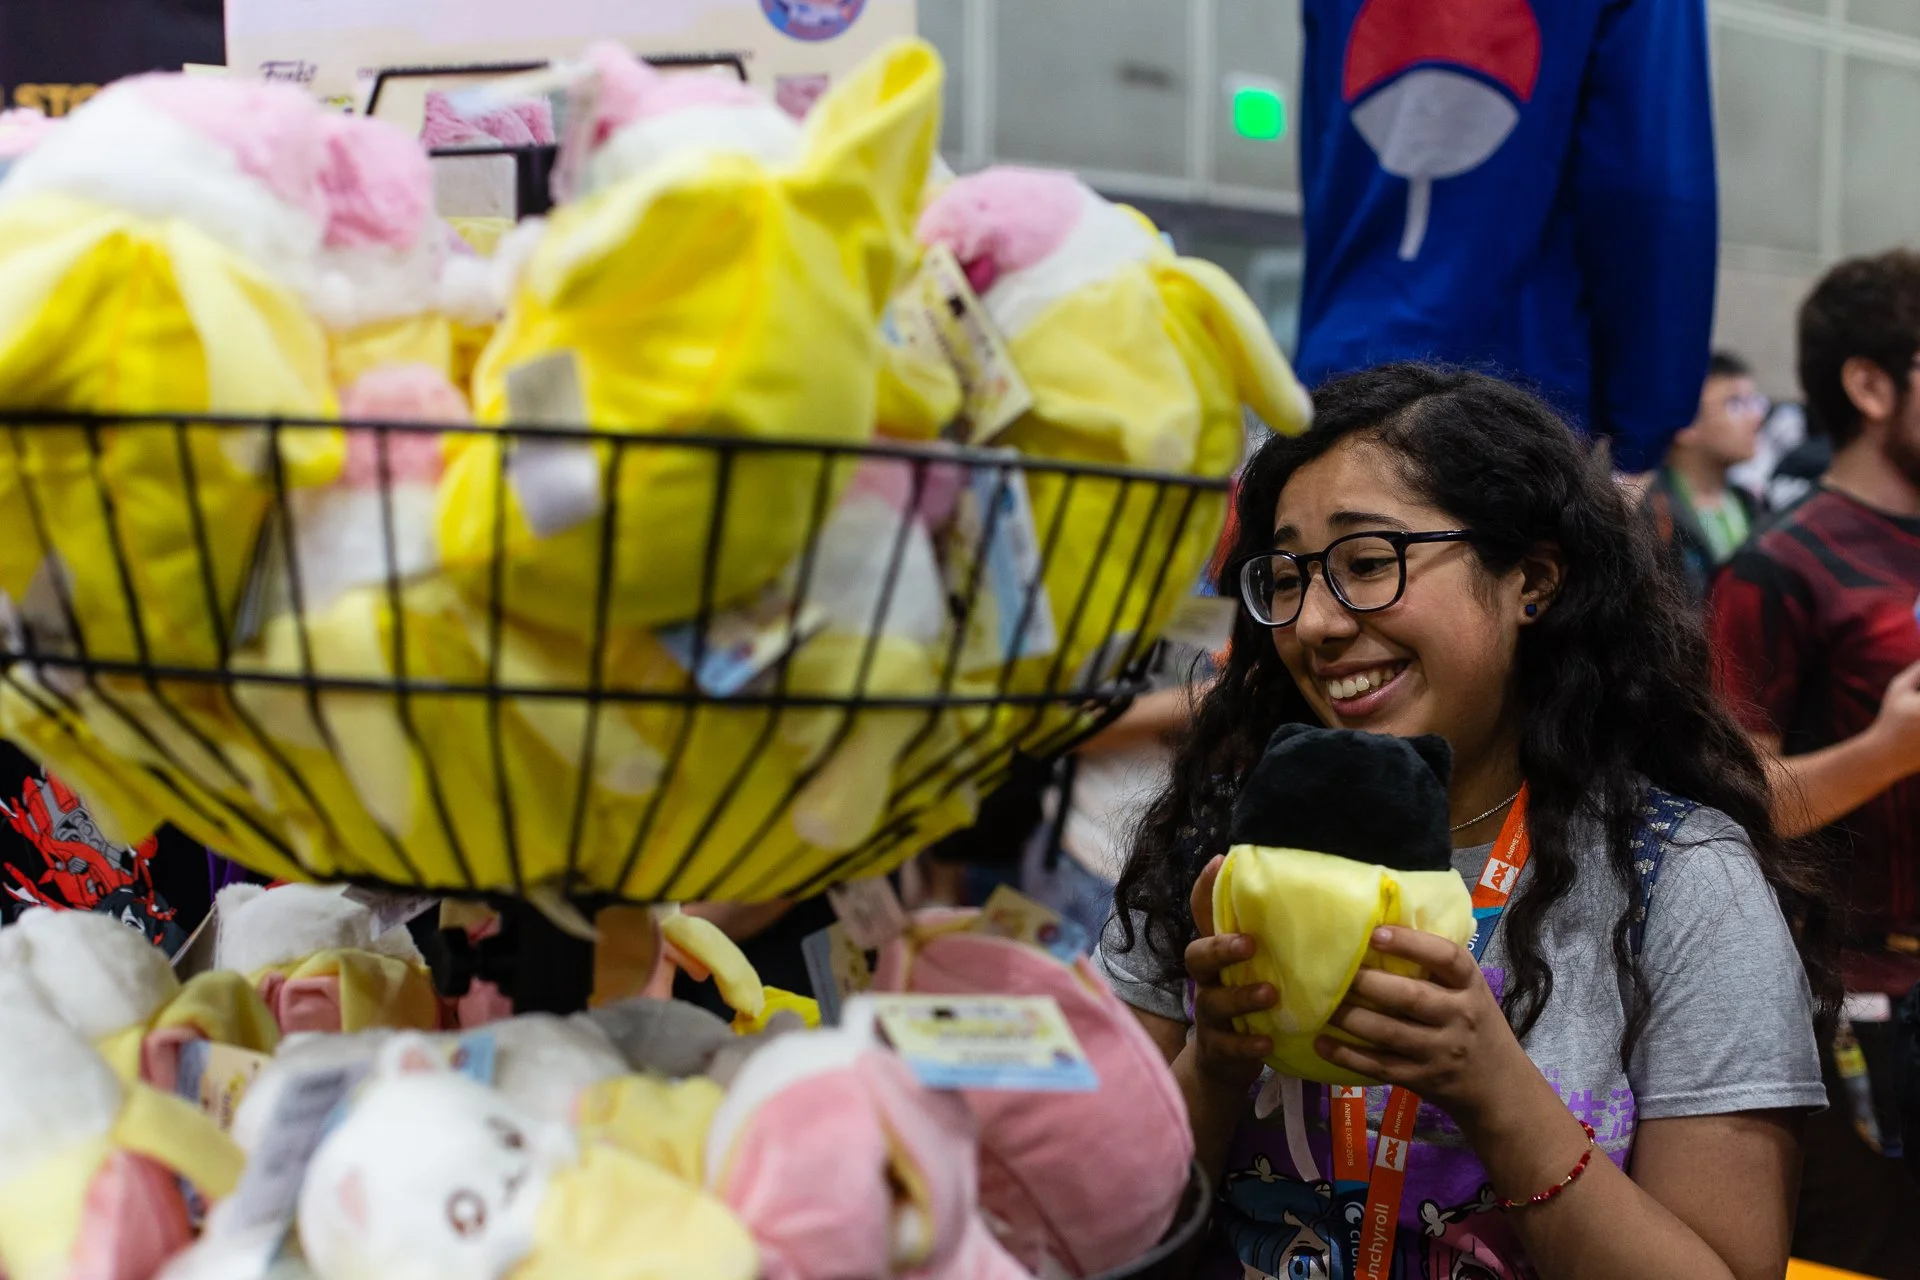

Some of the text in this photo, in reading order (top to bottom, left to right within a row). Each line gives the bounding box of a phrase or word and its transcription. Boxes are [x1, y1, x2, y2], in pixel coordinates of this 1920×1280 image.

[1505, 837, 1519, 860] ANIME
[1490, 862, 1511, 890] AX
[1343, 1102, 1354, 1166] ANIME EXPO 2018
[1393, 1110, 1404, 1135] ANIME
[1384, 1138, 1400, 1169] AX
